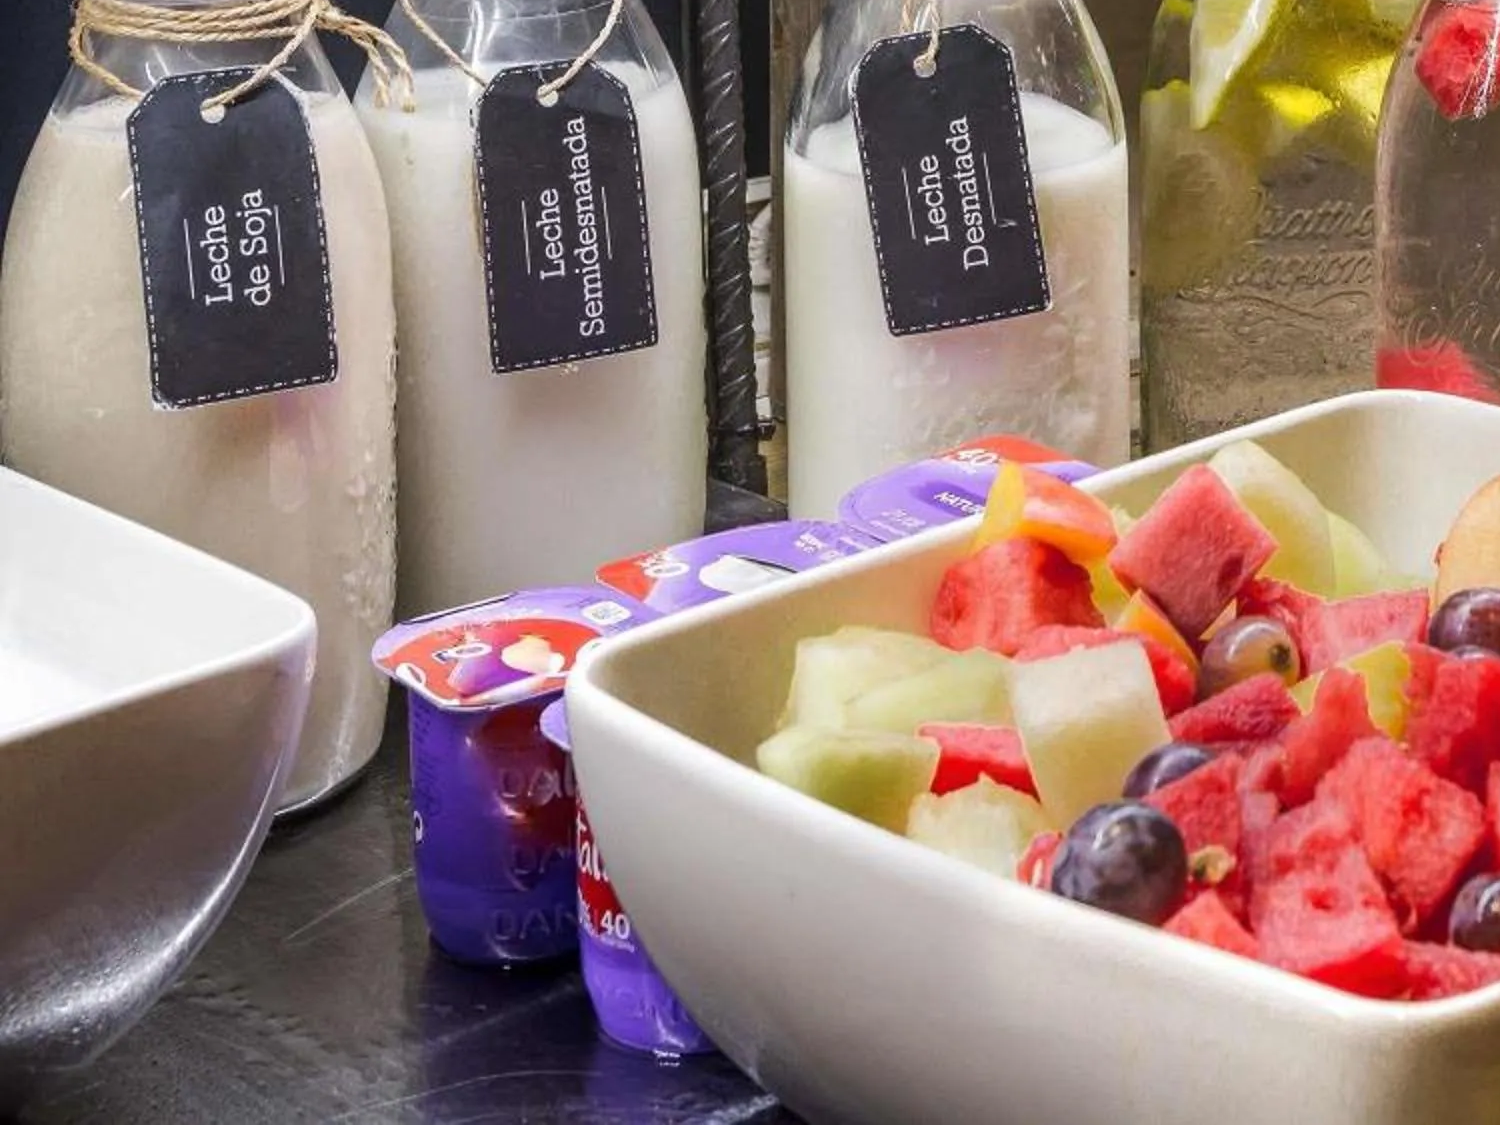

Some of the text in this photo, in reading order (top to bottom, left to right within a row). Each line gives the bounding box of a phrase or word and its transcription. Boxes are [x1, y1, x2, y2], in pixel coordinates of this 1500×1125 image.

[235, 187, 273, 306] de Soja
[535, 187, 566, 281] Leche
[562, 114, 607, 337] Semidesnatada
[917, 153, 951, 245] Leche
[945, 114, 990, 271] Desnatada
[200, 204, 234, 307] Leche
